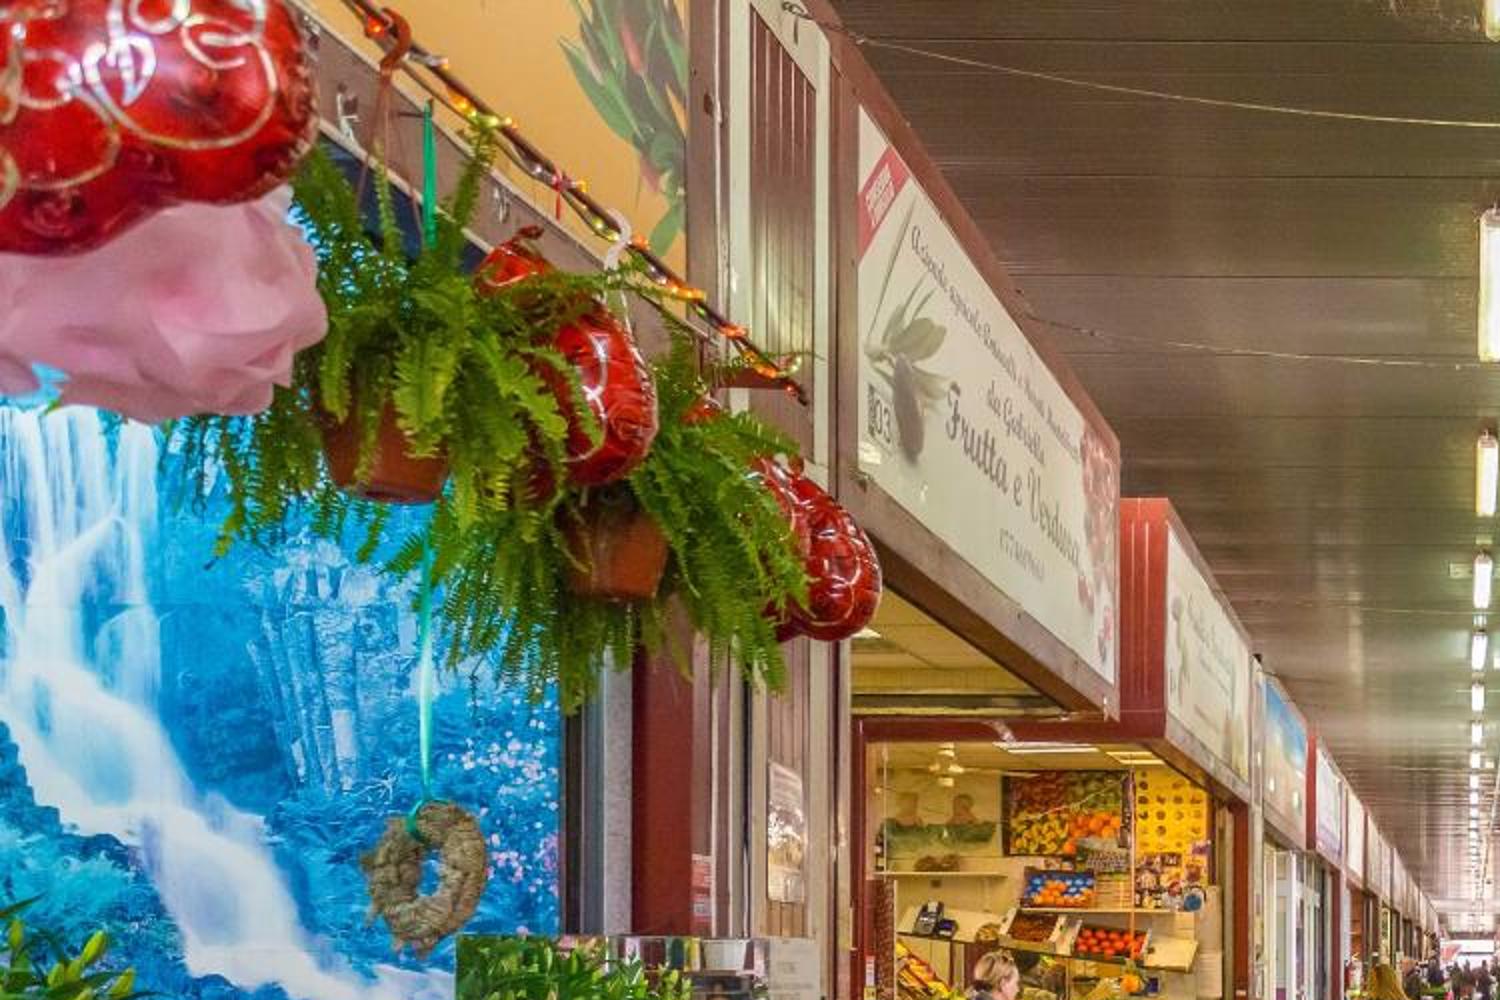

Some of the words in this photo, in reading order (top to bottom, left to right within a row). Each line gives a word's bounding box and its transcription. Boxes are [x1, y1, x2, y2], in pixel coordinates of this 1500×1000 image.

[946, 381, 1009, 494] Frutta
[1013, 474, 1023, 507] e
[1027, 466, 1080, 567] Verdura
